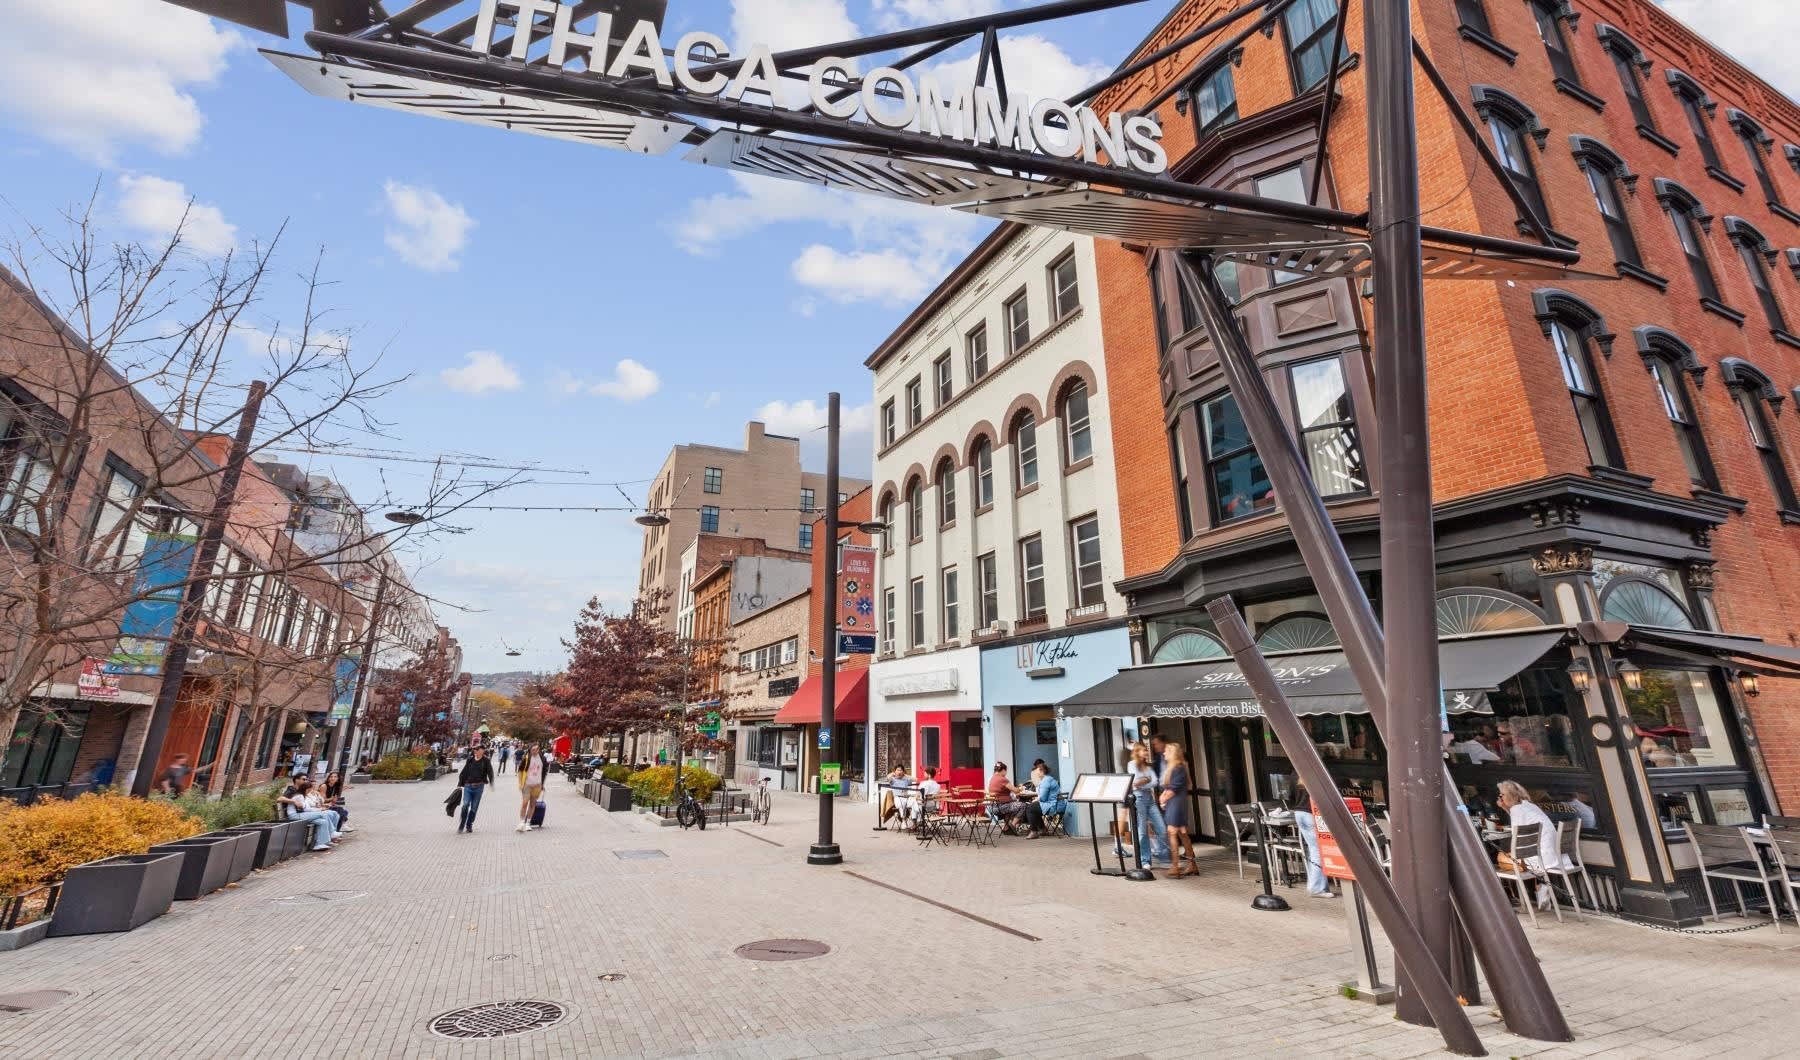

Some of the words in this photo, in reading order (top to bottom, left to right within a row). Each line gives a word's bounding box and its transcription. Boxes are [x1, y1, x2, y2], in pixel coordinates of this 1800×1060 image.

[471, 0, 788, 108] ITHACA
[808, 56, 1168, 174] COMMONS
[1017, 644, 1033, 668] LEV
[1036, 635, 1079, 667] Kitchen
[1152, 703, 1192, 715] Simeon's
[1193, 702, 1239, 715] American
